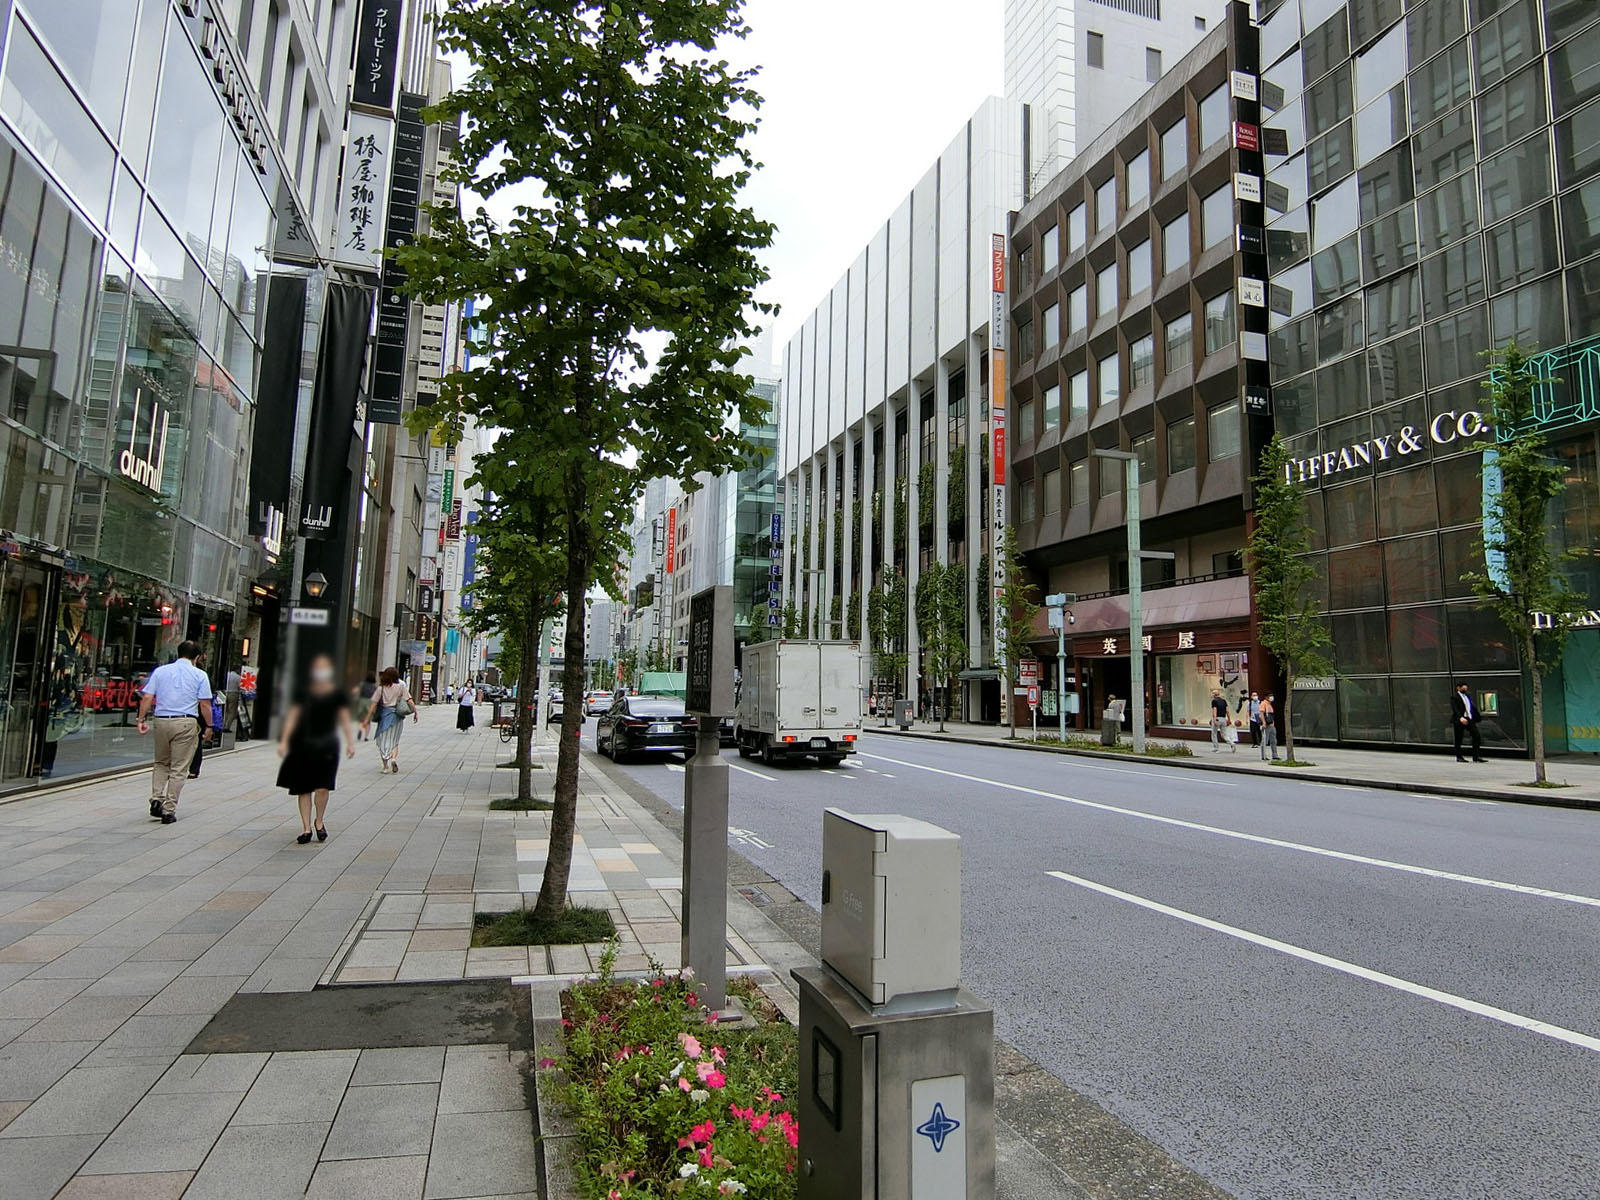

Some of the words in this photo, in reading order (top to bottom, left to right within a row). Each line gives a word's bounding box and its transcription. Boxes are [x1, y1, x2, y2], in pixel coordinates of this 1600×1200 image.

[369, 8, 389, 93] グルービー・ツアー
[344, 134, 383, 251] 椿屋珈琲店
[120, 388, 170, 493] dunhill
[1279, 434, 1392, 485] TIFFANY
[1397, 425, 1423, 455] &
[302, 503, 332, 527] dunhill
